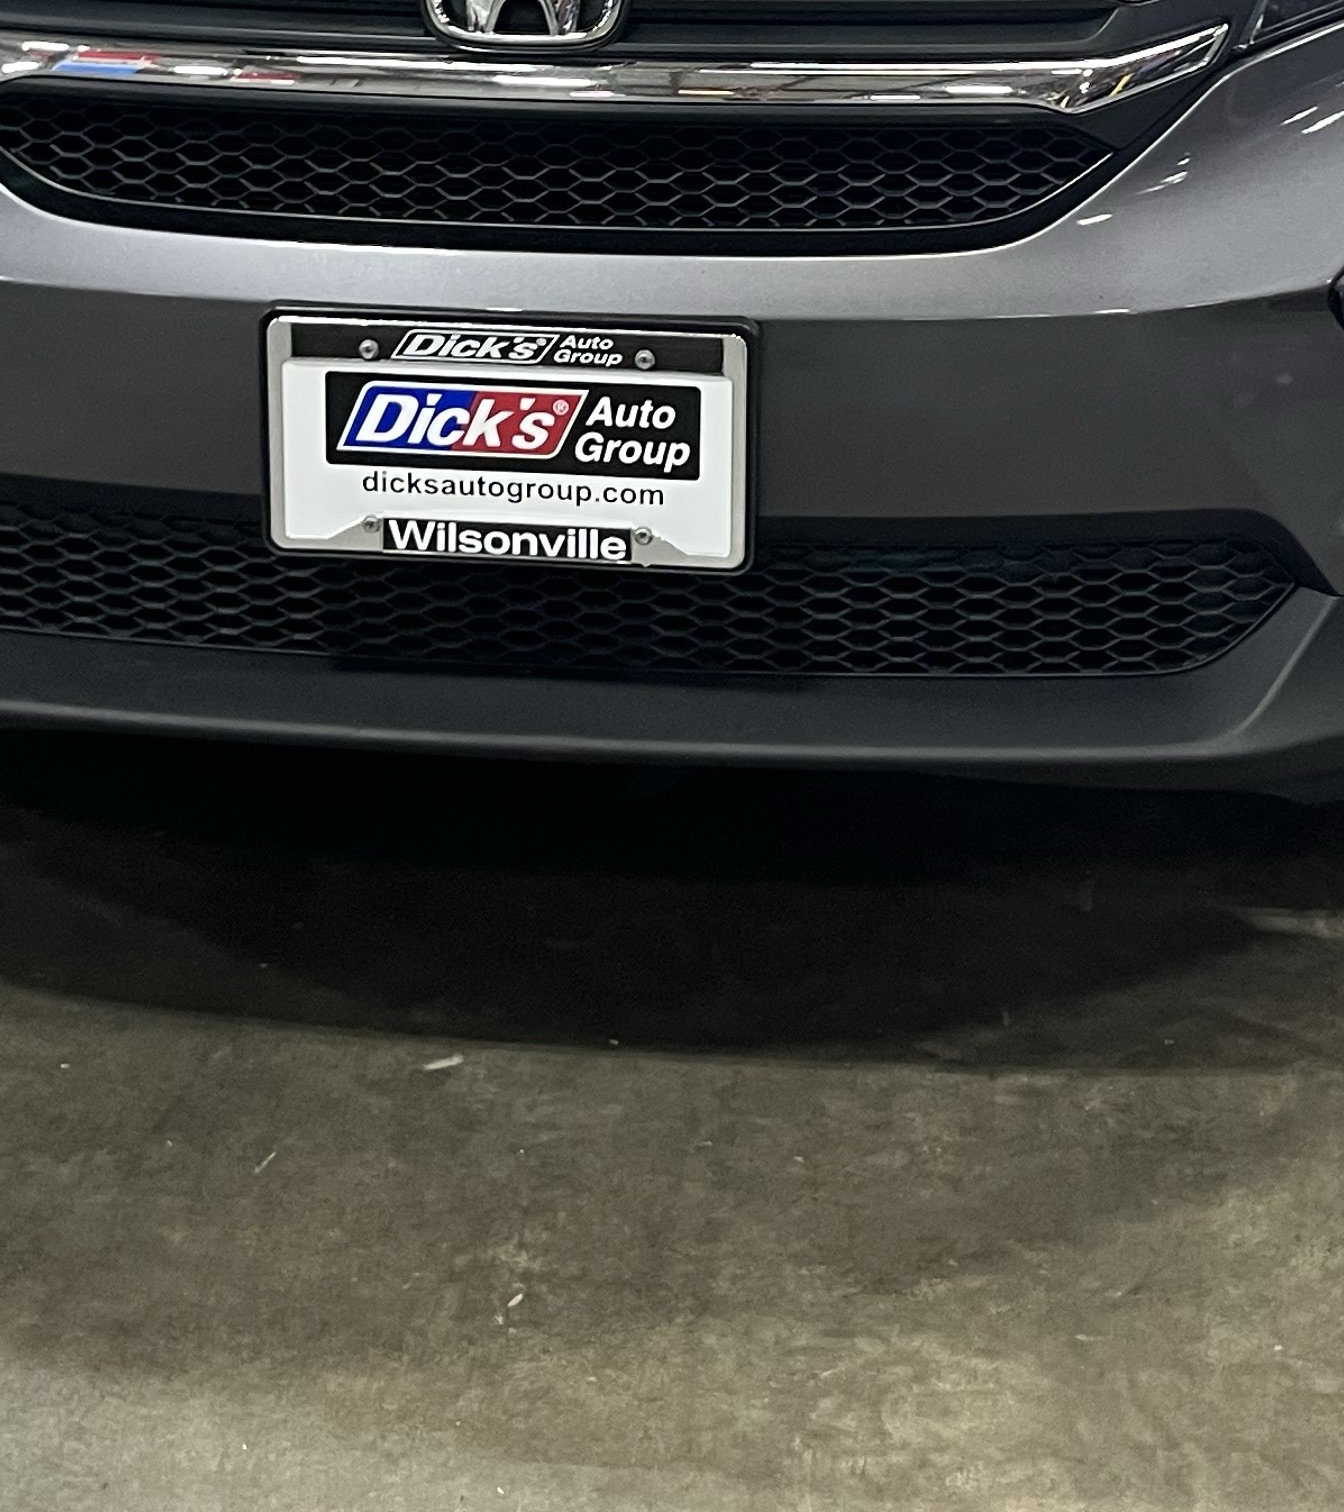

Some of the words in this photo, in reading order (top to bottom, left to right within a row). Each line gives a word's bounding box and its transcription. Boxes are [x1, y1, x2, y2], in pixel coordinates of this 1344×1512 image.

[403, 334, 540, 360] Dick's
[560, 335, 614, 351] Auto
[553, 349, 624, 367] Group
[355, 393, 556, 450] Dick's
[585, 396, 676, 430] Auto
[574, 431, 691, 473] Group
[362, 471, 665, 507] dicksautogroup.com
[387, 519, 627, 561] Wilsonville
